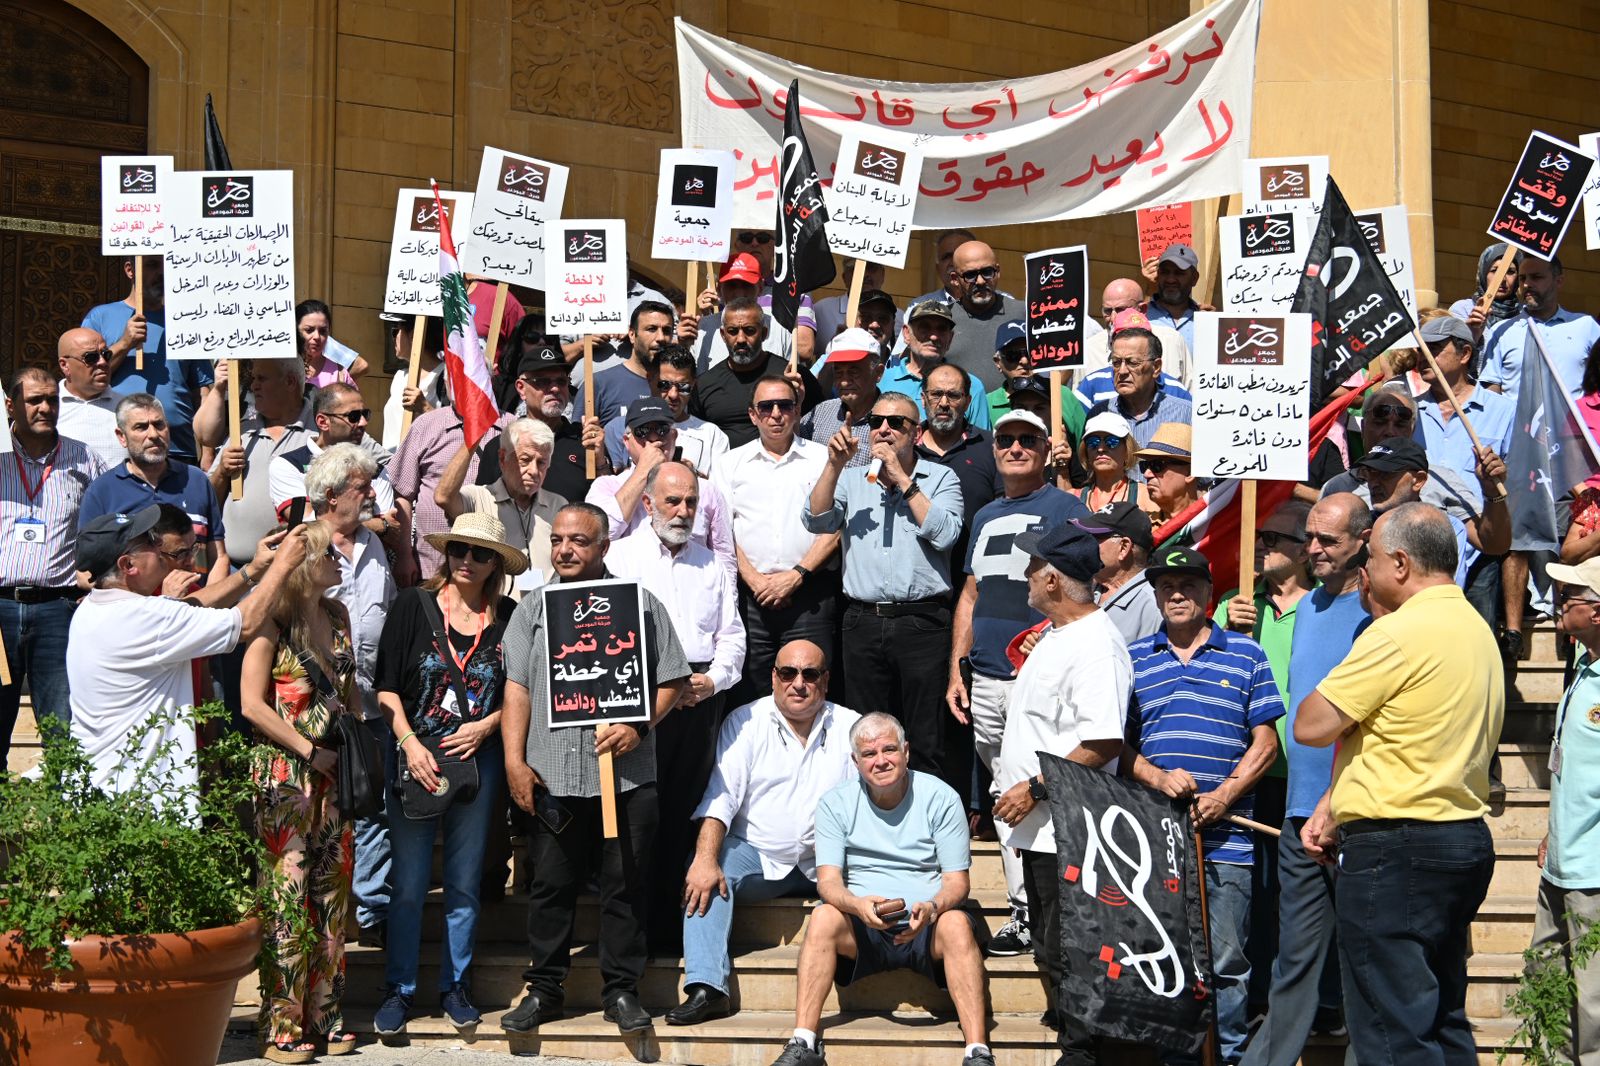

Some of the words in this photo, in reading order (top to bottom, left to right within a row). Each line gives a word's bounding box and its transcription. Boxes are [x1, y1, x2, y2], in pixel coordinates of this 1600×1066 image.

[1048, 18, 1226, 119] نرفض
[942, 86, 1018, 142] أي
[1181, 98, 1234, 163] لا
[1064, 131, 1165, 188] يعيد
[919, 152, 1045, 201] حقوق
[835, 181, 867, 198] للبنان
[1518, 177, 1568, 208] وقف
[154, 204, 161, 213] لا
[894, 194, 911, 208] لا
[1510, 191, 1559, 225] سرقة
[494, 204, 545, 226] يقاتي
[674, 210, 711, 229] جمعية
[832, 206, 882, 228] استرجاع
[110, 221, 145, 232] القوانين
[148, 221, 164, 233] على
[170, 224, 193, 243] تبدأ
[472, 221, 514, 244] قروضك
[886, 221, 906, 236] قبل
[1494, 214, 1538, 242] ميقاتي
[109, 236, 138, 249] حقوقنا
[658, 235, 694, 246] المودعين
[697, 235, 723, 247] صرخة
[828, 233, 871, 253] المودعين
[872, 243, 901, 257] حقوق
[1539, 231, 1553, 251] يا
[241, 249, 272, 270] تطهير
[273, 254, 290, 267] من
[517, 258, 533, 275] أو
[172, 275, 209, 294] التدخل
[213, 280, 239, 296] وعدم
[242, 274, 290, 291] والوزارات
[565, 273, 593, 285] لخطة
[596, 274, 605, 286] لا
[564, 291, 606, 306] الحكومة
[1030, 295, 1079, 319] ممنوع
[173, 303, 208, 320] وليس
[213, 302, 240, 315] القضاء
[243, 302, 254, 319] في
[256, 300, 292, 319] السياسي
[588, 311, 622, 325] لشطب
[549, 312, 585, 328] الودائع
[1031, 313, 1077, 339] شطب
[203, 331, 225, 352] ورفع
[1348, 312, 1404, 352] صرخة
[1030, 340, 1080, 366] الودائع
[1199, 373, 1234, 390] الفائدة
[1238, 373, 1266, 393] شطب
[1266, 378, 1309, 396] تريدون
[1196, 398, 1236, 419] سنوات
[1251, 406, 1273, 422] عن
[1277, 402, 1303, 420] ماذا
[1232, 428, 1266, 447] فائدة
[1271, 431, 1302, 449] دون
[1212, 453, 1268, 476] للمودع
[553, 632, 598, 660] تمر
[604, 630, 636, 656] لن
[552, 660, 609, 682] خطة
[614, 655, 640, 685] أي
[554, 691, 597, 714] ودائعنا
[598, 685, 641, 714] تشطب
